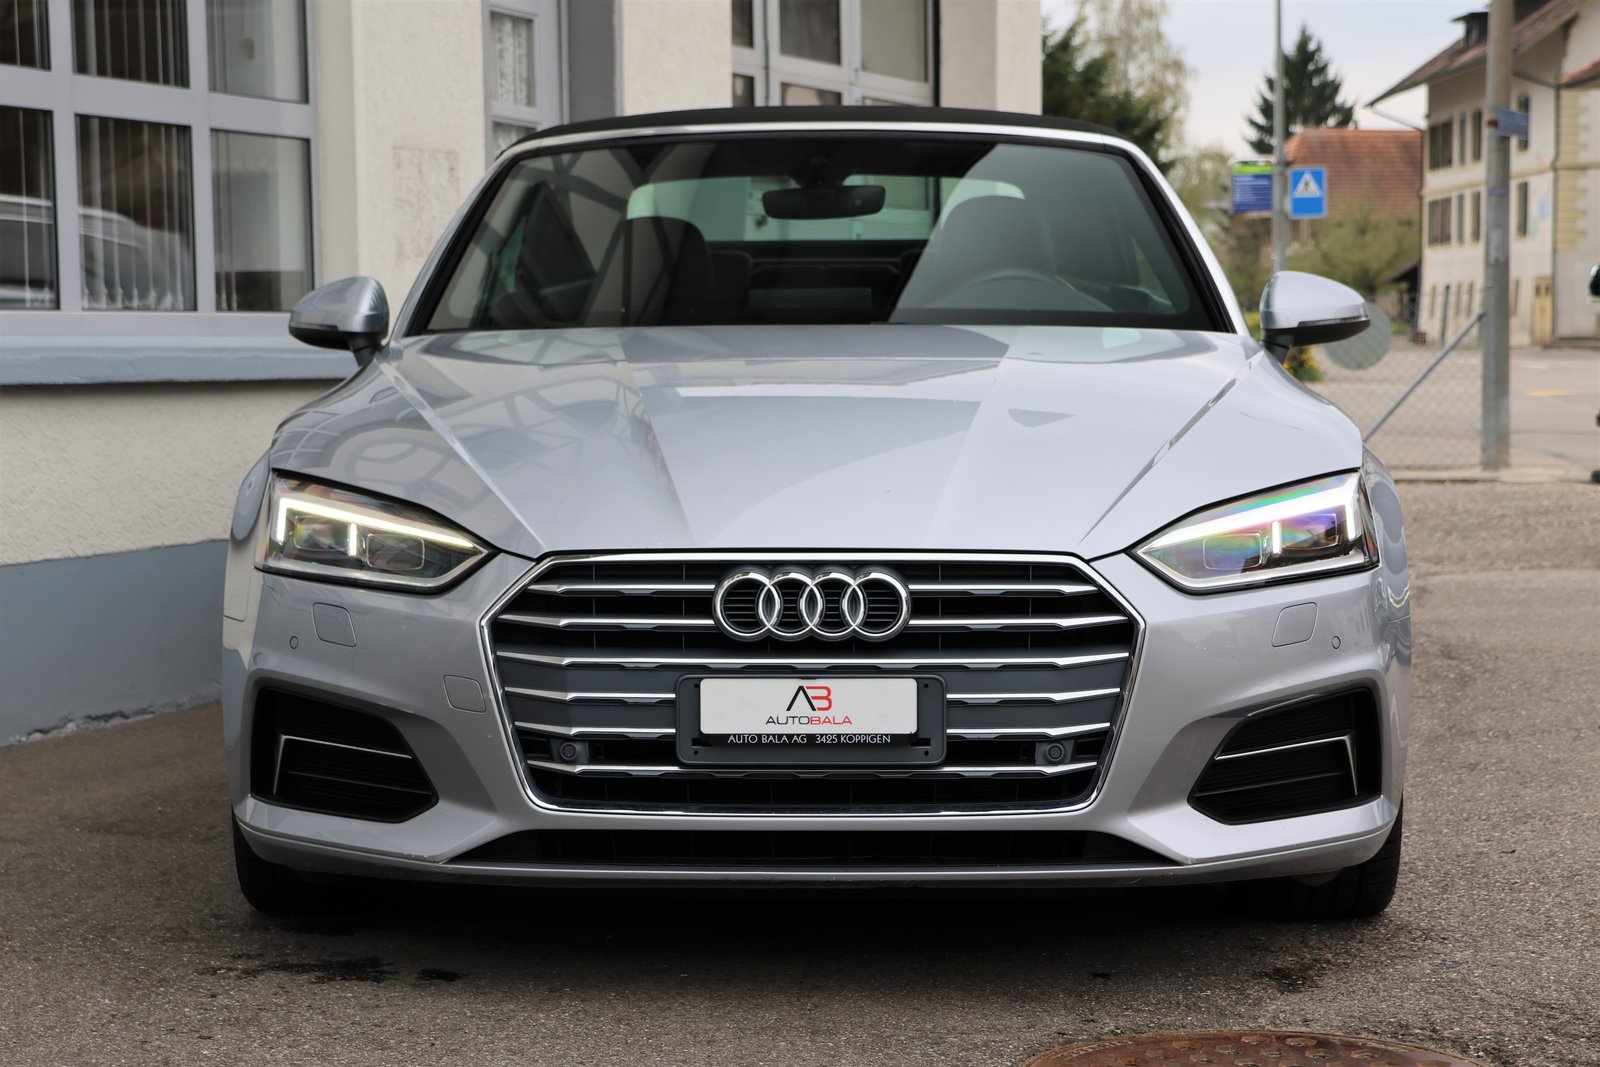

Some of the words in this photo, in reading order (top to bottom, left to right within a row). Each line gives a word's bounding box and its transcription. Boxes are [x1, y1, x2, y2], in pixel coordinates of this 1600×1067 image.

[786, 685, 832, 711] AB
[766, 716, 852, 725] AUTOBALA
[728, 734, 758, 744] AUTO
[761, 734, 788, 744] BALA
[792, 734, 807, 744] AG
[815, 734, 838, 744] 3425
[841, 734, 891, 744] KOPPIGEN
